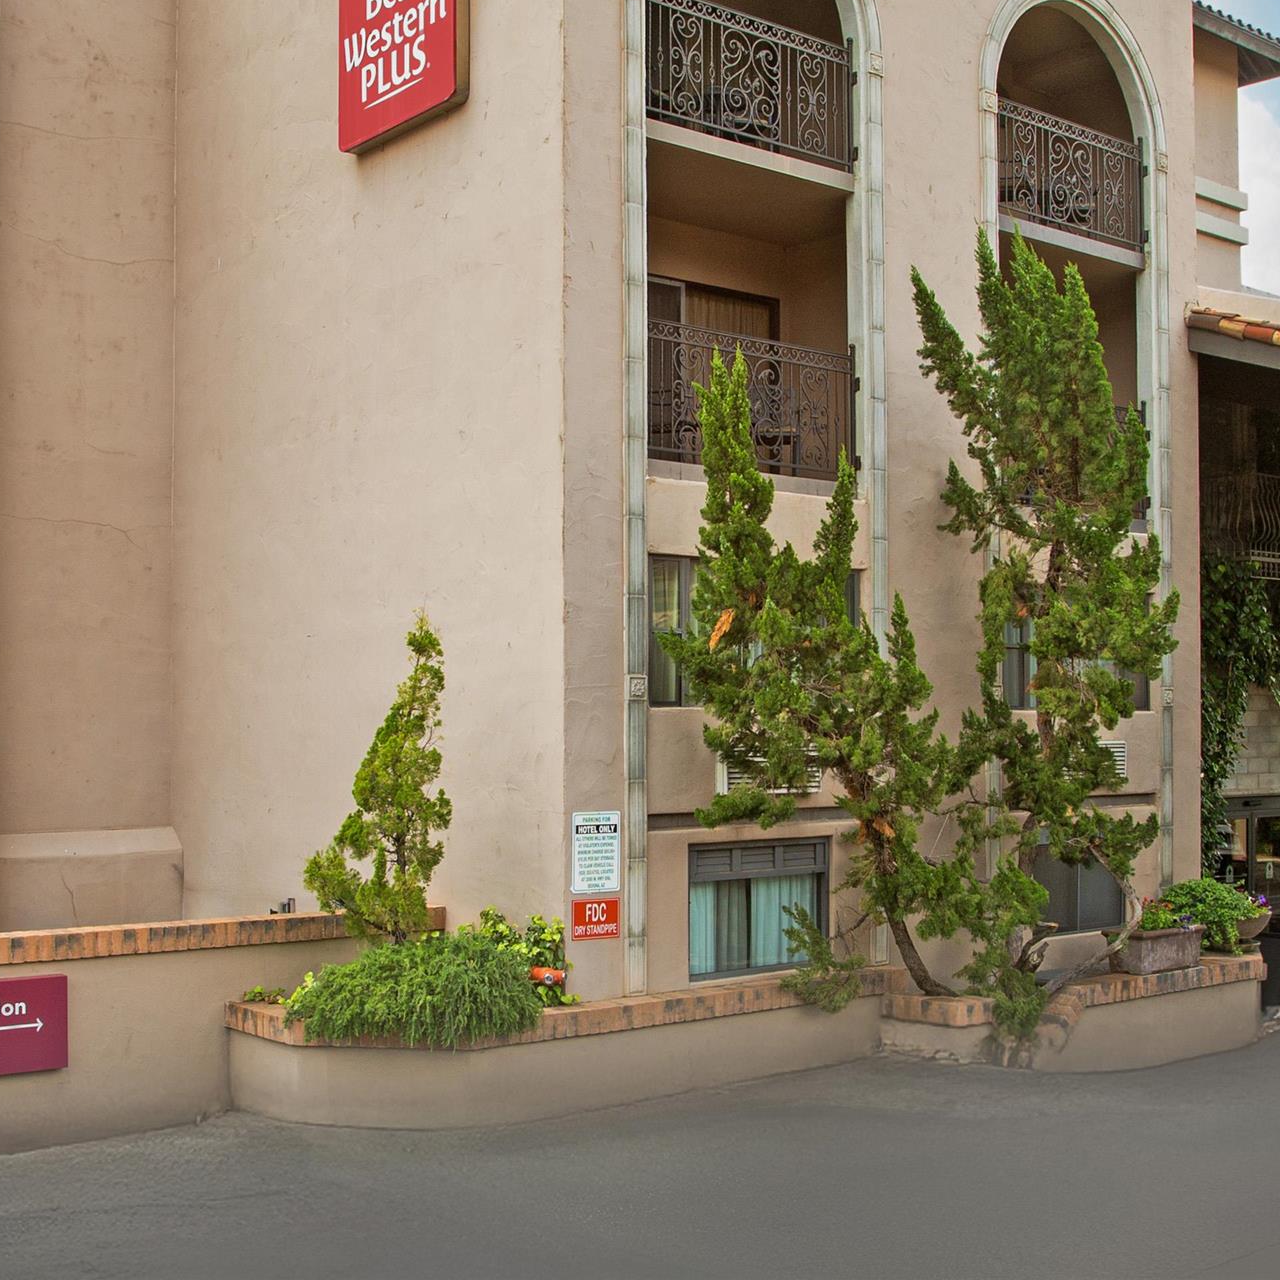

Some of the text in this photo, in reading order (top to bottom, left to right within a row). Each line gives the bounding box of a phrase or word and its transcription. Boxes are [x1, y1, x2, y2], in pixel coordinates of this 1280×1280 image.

[360, 34, 427, 103] PLUS
[577, 824, 616, 834] HOTEL ONLY
[585, 903, 607, 922] FDC
[574, 923, 617, 936] DRY STANDPIPE
